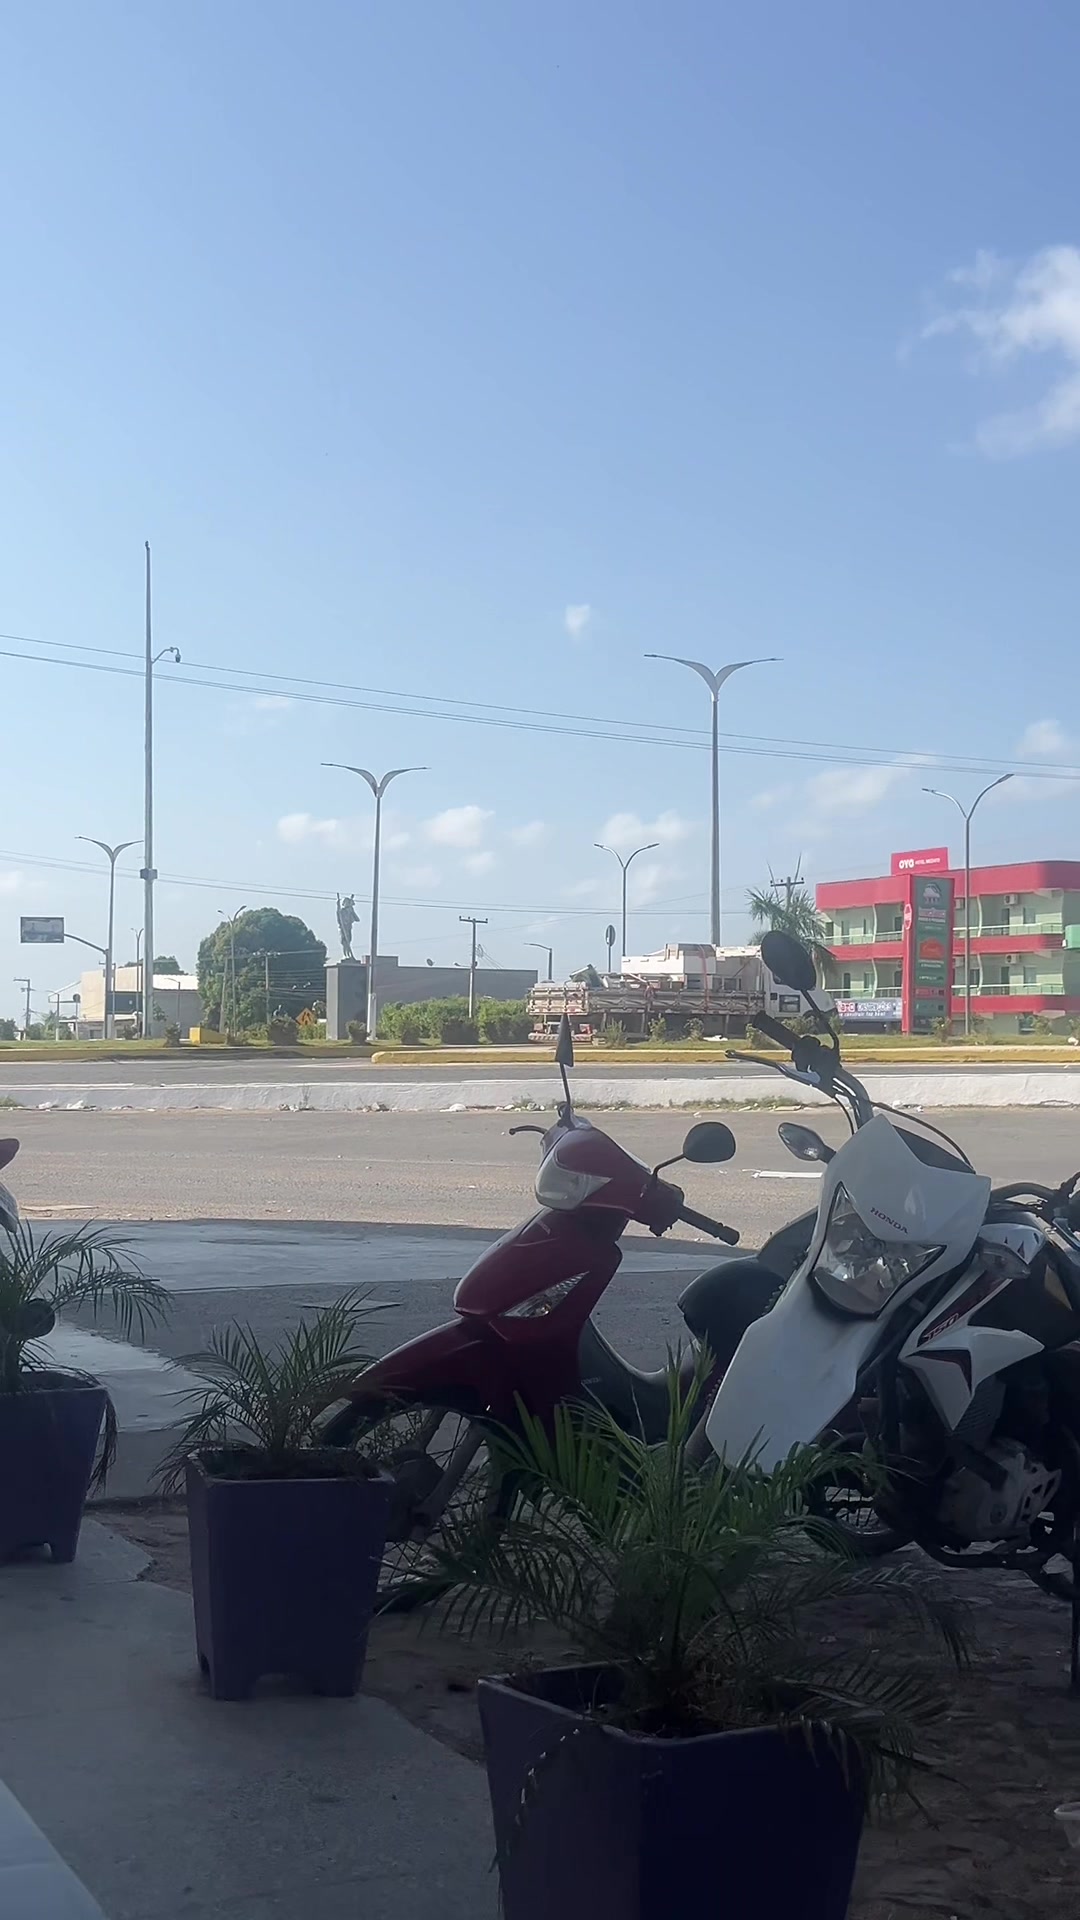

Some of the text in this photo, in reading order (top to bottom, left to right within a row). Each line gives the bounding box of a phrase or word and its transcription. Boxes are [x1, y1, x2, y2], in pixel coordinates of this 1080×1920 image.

[899, 858, 914, 869] OYO
[870, 1207, 908, 1234] HONDA
[923, 1312, 960, 1341] 150
